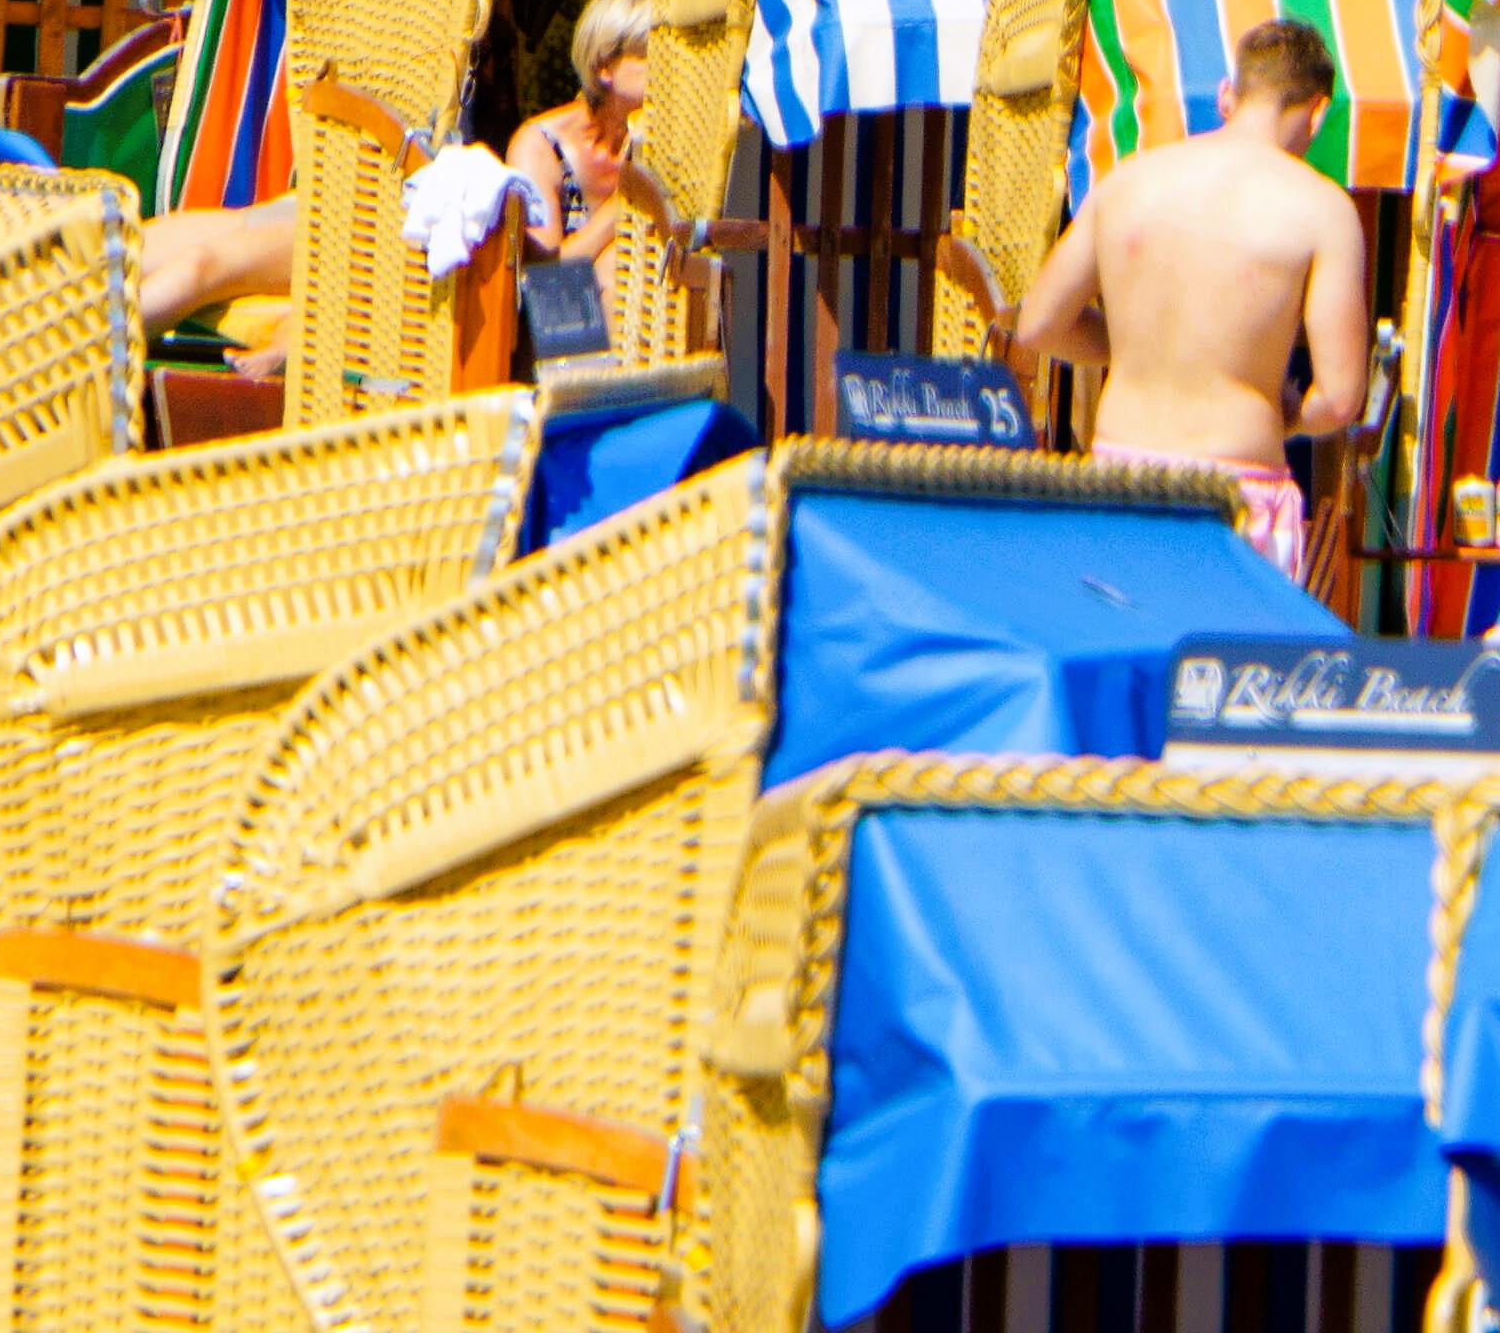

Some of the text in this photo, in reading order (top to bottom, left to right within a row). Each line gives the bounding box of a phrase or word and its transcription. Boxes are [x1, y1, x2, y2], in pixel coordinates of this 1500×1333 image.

[920, 368, 973, 419] Beach
[980, 387, 1021, 438] 25
[1222, 651, 1351, 727] Rikki
